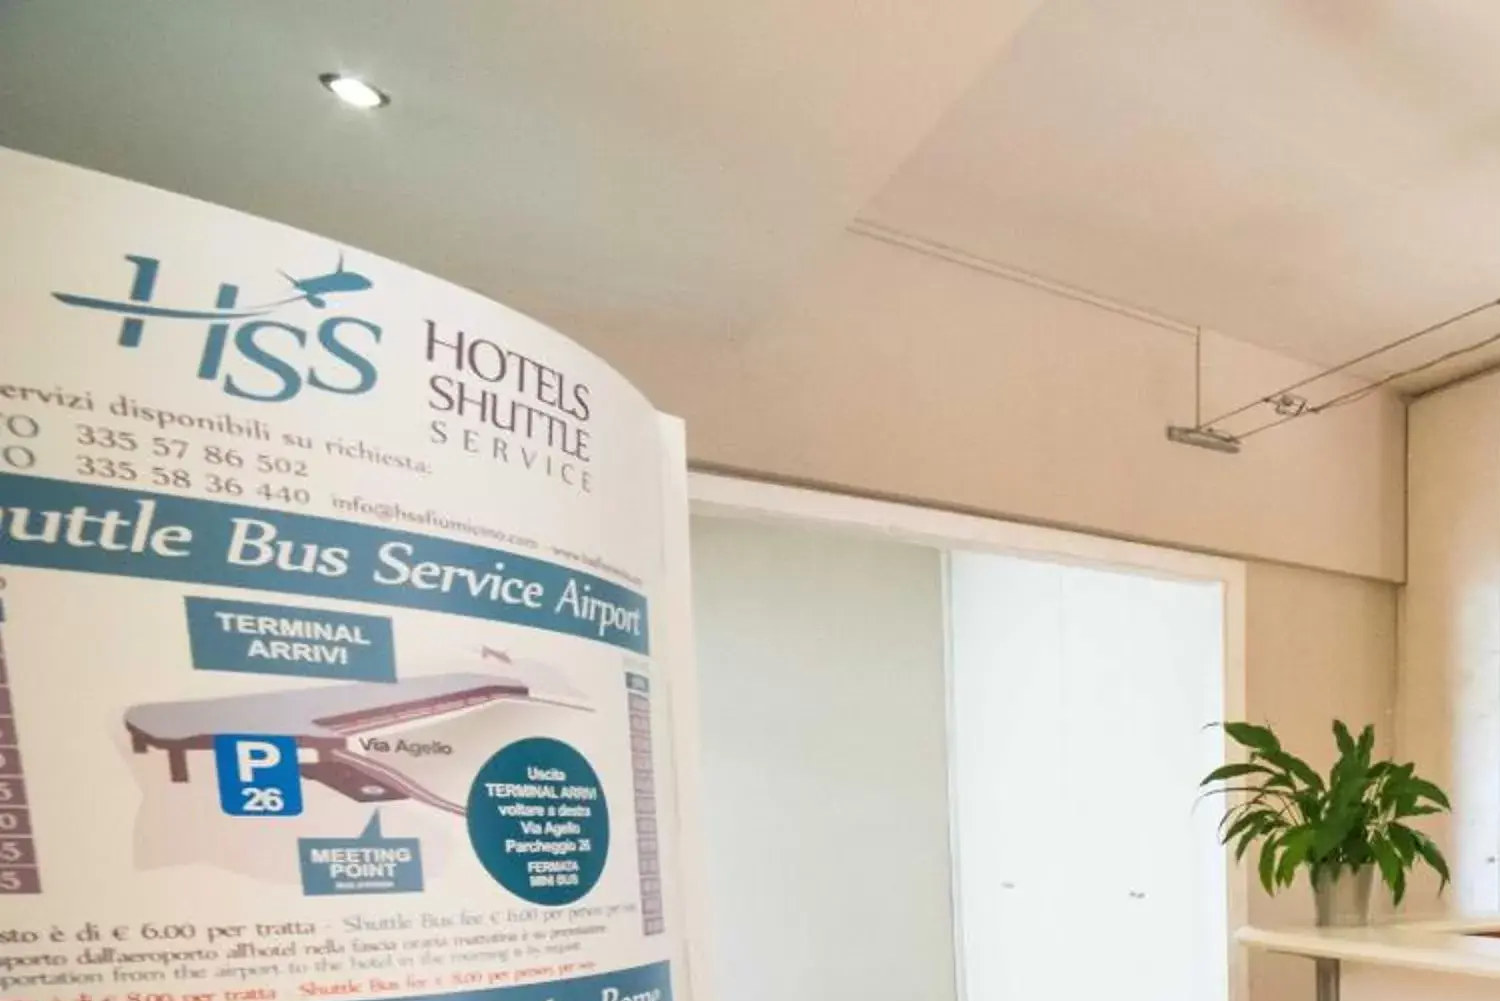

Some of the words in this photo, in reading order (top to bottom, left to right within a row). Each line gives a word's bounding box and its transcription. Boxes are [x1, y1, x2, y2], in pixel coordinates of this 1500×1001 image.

[52, 254, 382, 402] HSS
[424, 319, 591, 422] HOTELS
[109, 395, 271, 442] disponibili
[281, 431, 313, 449] su
[428, 375, 591, 462] SHUTTLE
[76, 423, 139, 451] 335
[151, 436, 189, 460] 57
[202, 444, 244, 469] 86
[256, 453, 310, 478] 502
[430, 420, 593, 494] SERVICE
[75, 454, 138, 482] 335
[151, 466, 192, 490] 58
[204, 472, 244, 497] 36
[255, 482, 311, 506] 440
[0, 499, 193, 558] uttle
[226, 517, 349, 579] Bus
[373, 541, 544, 609] Service
[554, 579, 642, 638] Airport
[214, 611, 372, 646] TERMINAL
[248, 641, 349, 665] ARRIVI
[235, 741, 281, 783] P
[359, 737, 391, 753] Via
[240, 787, 285, 812] 26
[484, 782, 559, 799] TERMINAL
[310, 848, 413, 864] MEETING
[329, 862, 398, 879] POINT
[50, 924, 66, 942] è
[75, 921, 100, 942] di
[112, 924, 130, 941] €
[141, 921, 196, 941] 6.00
[207, 925, 246, 945] per
[255, 920, 316, 937] tratta
[75, 947, 219, 968] dall'aeroporto
[112, 966, 166, 984] from
[173, 963, 208, 981] the
